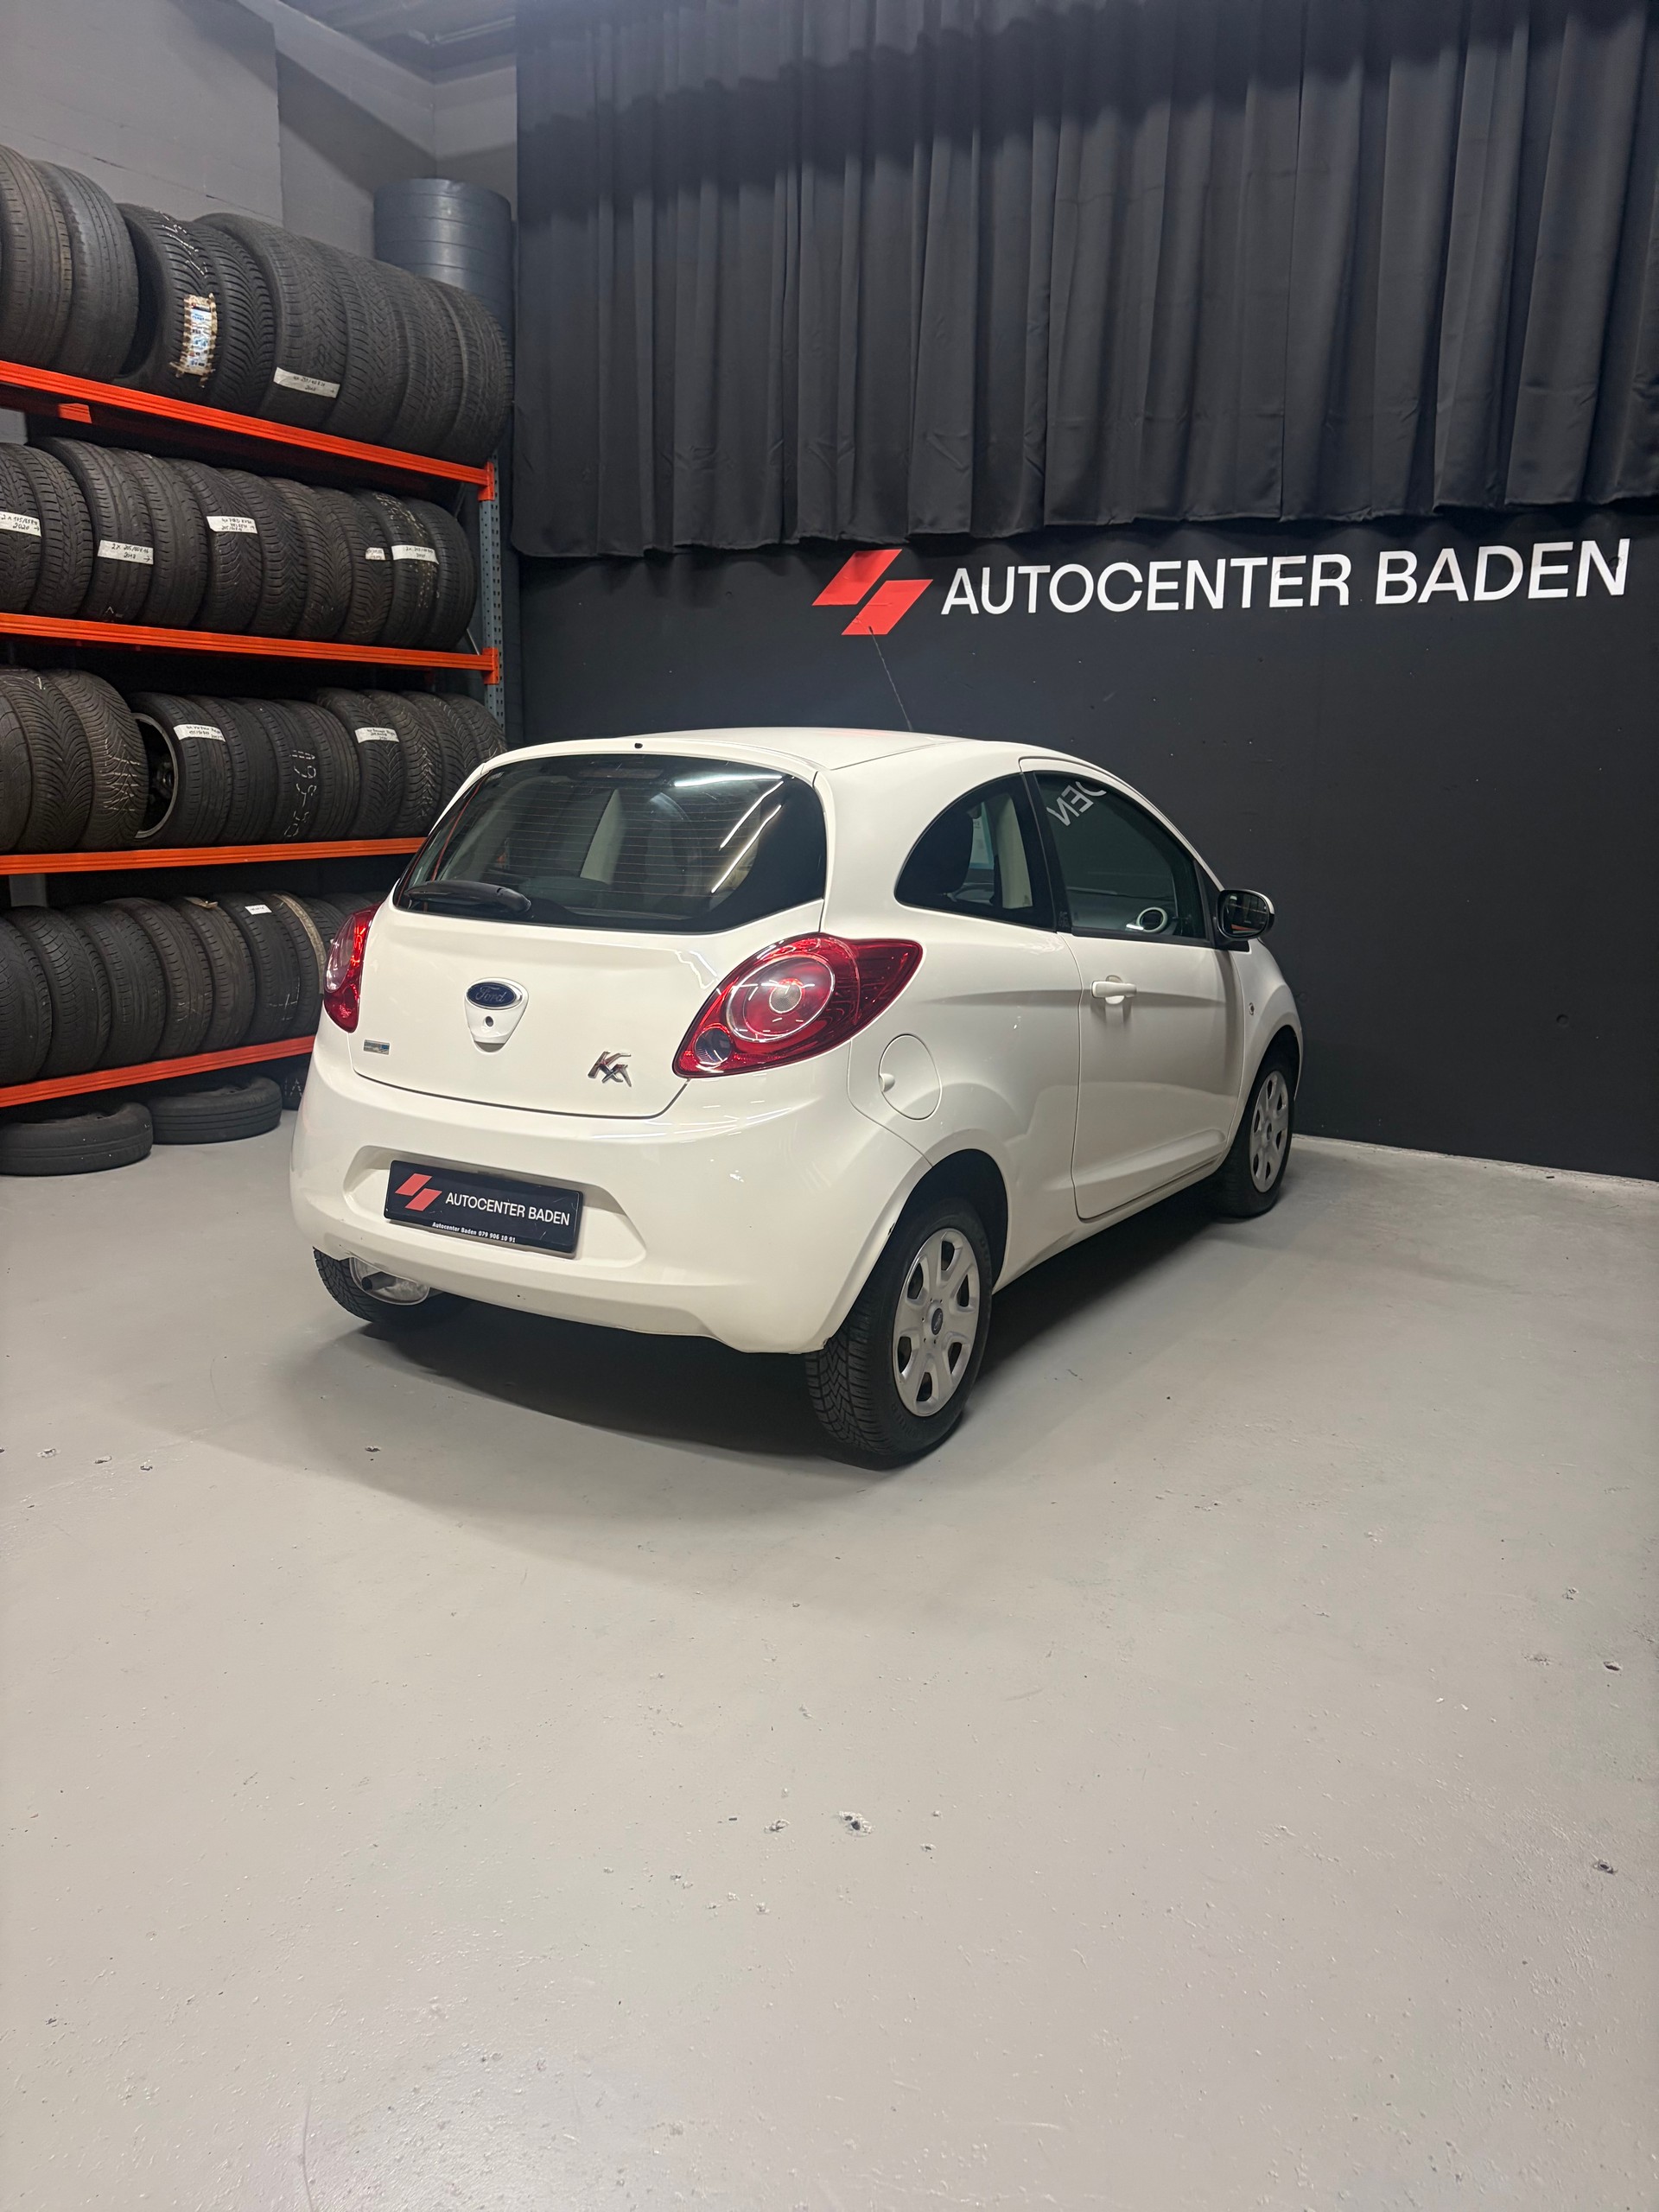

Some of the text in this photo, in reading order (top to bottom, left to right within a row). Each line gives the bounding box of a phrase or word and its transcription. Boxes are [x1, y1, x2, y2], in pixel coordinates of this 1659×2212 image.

[941, 538, 1630, 614] AUTOCENTER BADEN
[474, 985, 507, 1003] Ford
[445, 1192, 570, 1226] AUTOCENTER BADEN
[432, 1222, 461, 1232] Autocenter
[461, 1227, 477, 1236] Baden
